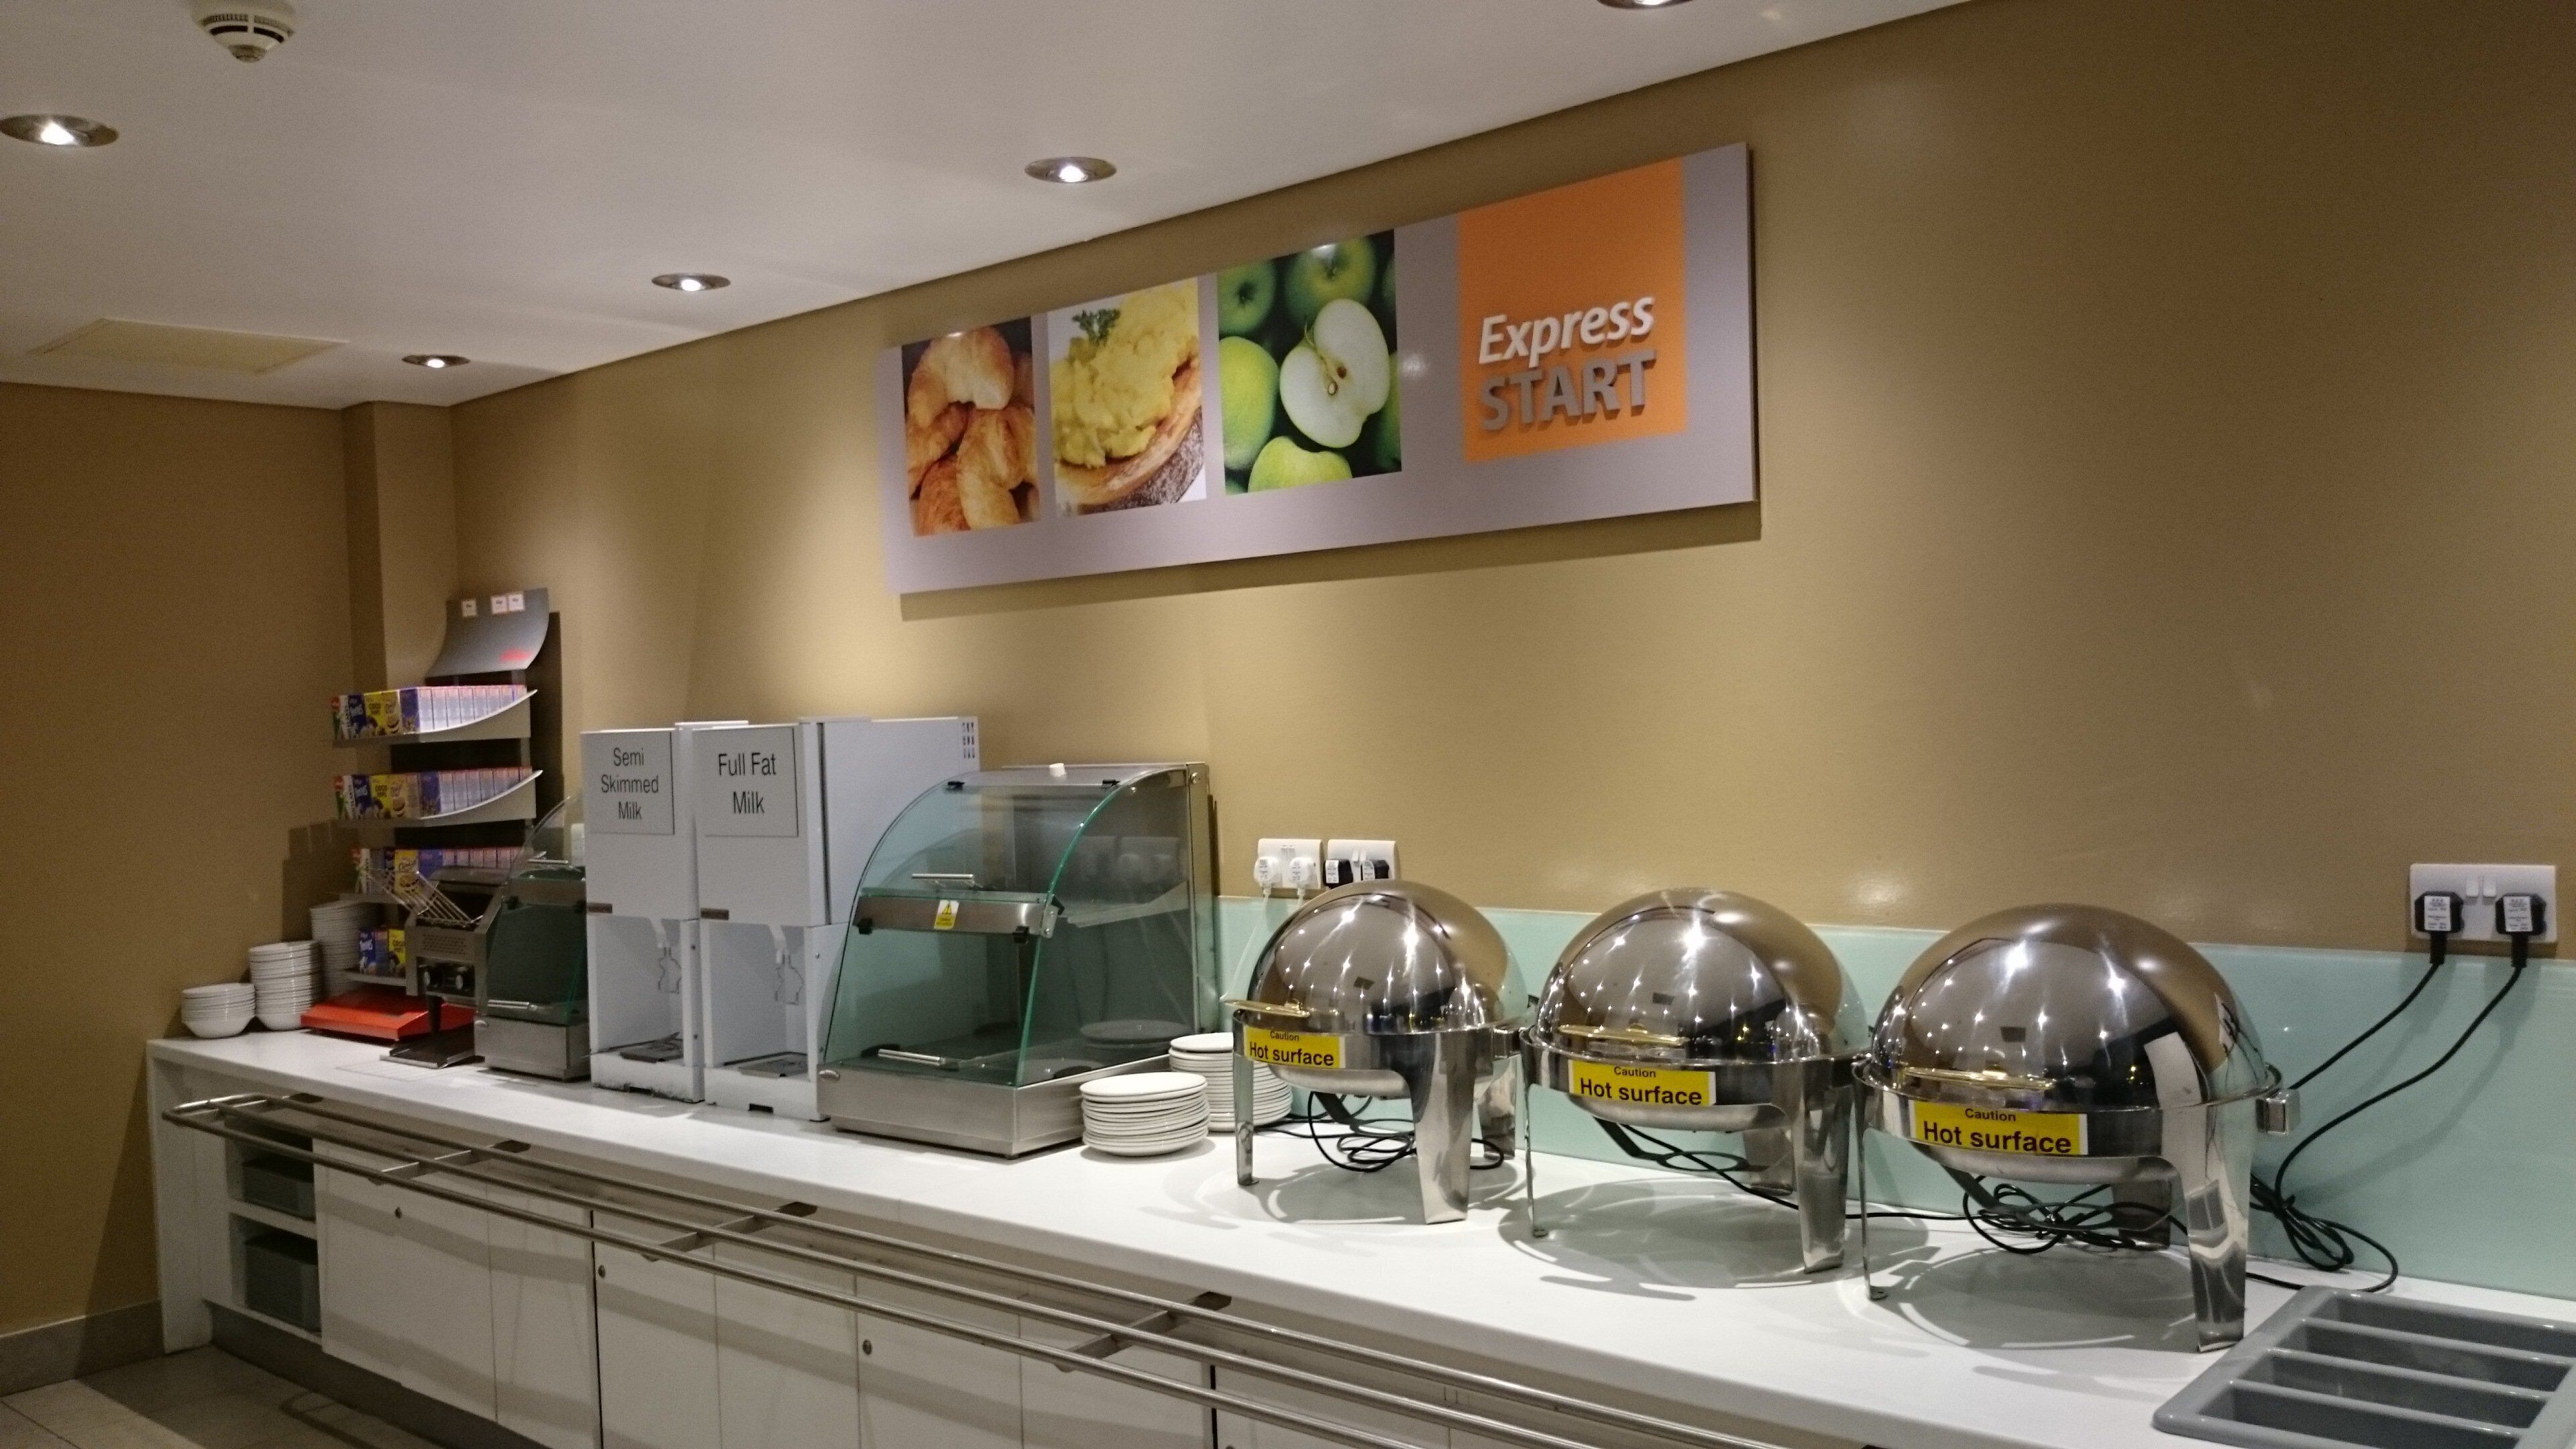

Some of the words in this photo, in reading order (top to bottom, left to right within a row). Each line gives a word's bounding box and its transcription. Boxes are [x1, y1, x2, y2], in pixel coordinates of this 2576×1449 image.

[1479, 296, 1656, 368] Express
[1480, 350, 1657, 431] START
[613, 747, 645, 767] Semi
[718, 753, 746, 776] Full
[751, 752, 777, 776] Fat
[601, 774, 659, 794] Skimmed
[618, 801, 643, 820] Milk
[733, 791, 765, 815] Milk
[1270, 1030, 1299, 1041] Caution
[1249, 1041, 1269, 1059] Hot
[1273, 1048, 1334, 1066] surface
[1614, 1066, 1656, 1077] Caution
[1580, 1077, 1612, 1098] Hot
[1619, 1085, 1702, 1106] surface
[1965, 1108, 2017, 1122] Caution
[1923, 1121, 1962, 1145] Hot
[1970, 1131, 2072, 1153] surface
